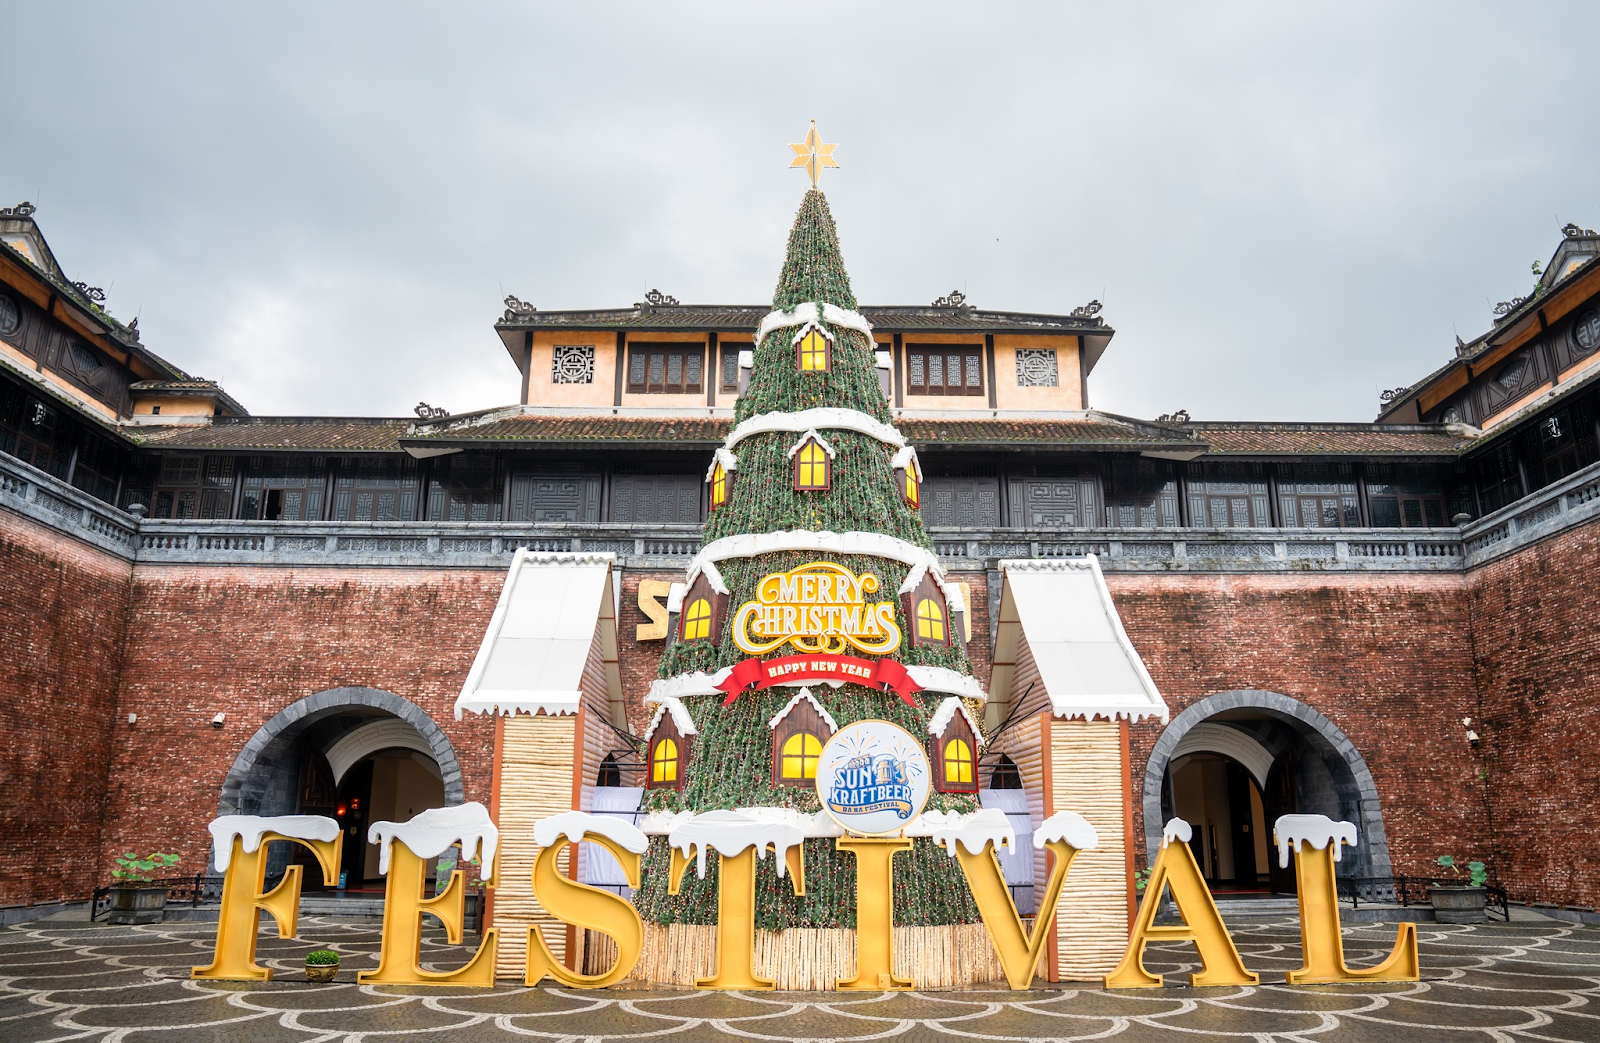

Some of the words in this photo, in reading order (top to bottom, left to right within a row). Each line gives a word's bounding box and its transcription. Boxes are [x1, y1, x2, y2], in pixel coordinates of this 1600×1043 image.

[758, 563, 878, 604] MERRY
[734, 603, 900, 654] CHRISTMAS
[768, 661, 807, 679] HAPPY
[811, 660, 837, 673] NEW
[841, 662, 871, 679] YEAR
[835, 766, 873, 789] SUN
[830, 784, 912, 805] KRAFTBEER
[864, 801, 899, 812] FESTIVAL
[190, 818, 1420, 991] FESTIVAL
